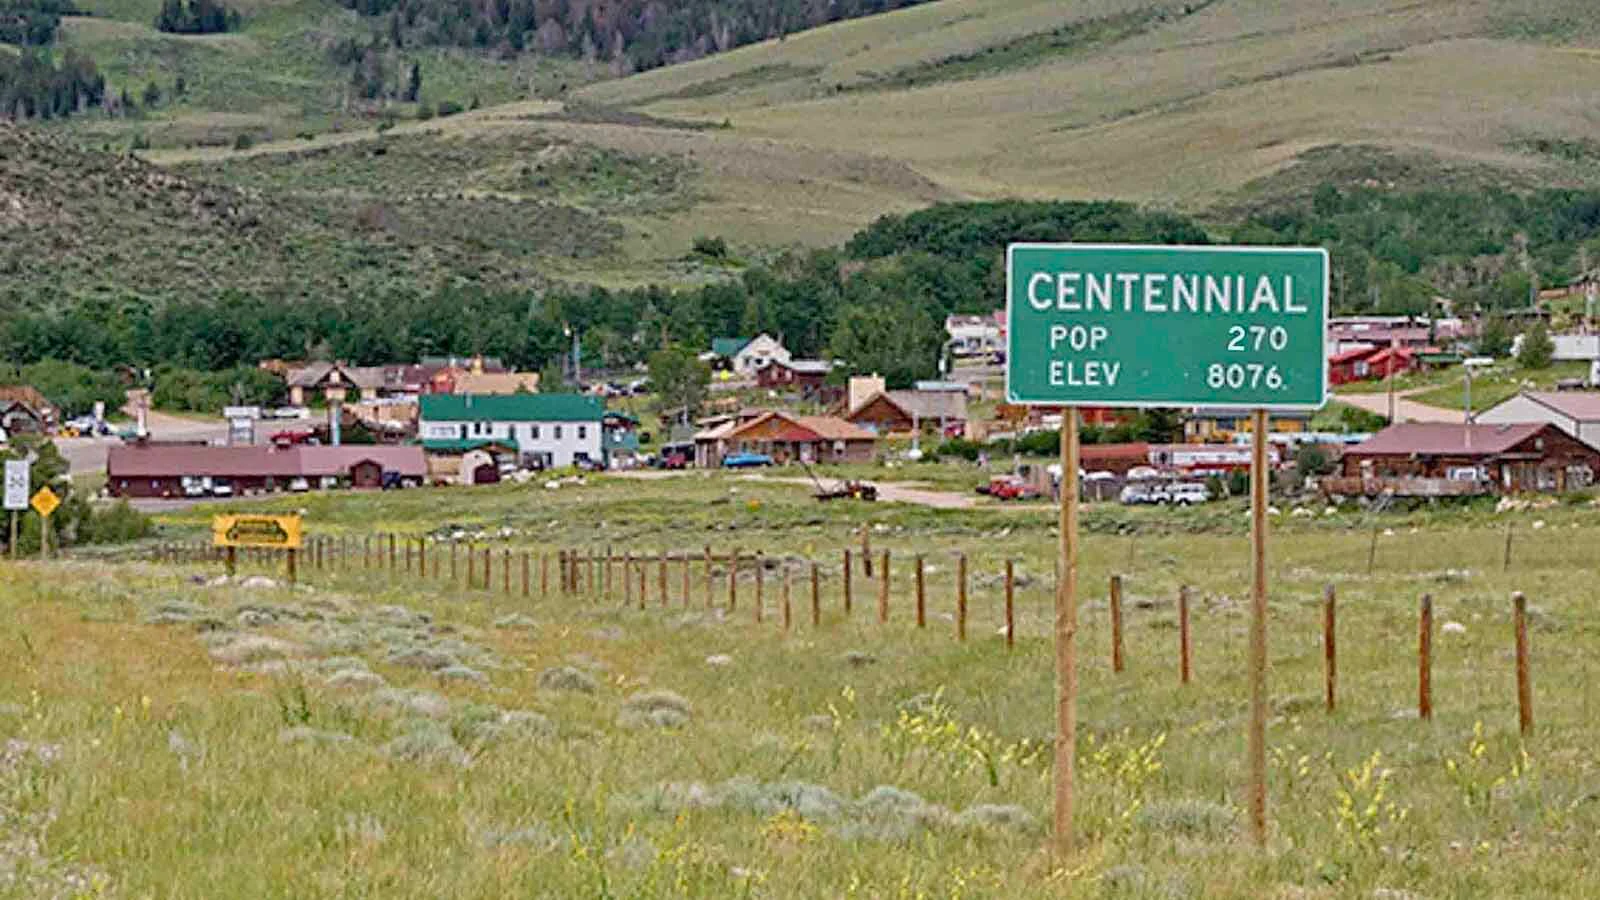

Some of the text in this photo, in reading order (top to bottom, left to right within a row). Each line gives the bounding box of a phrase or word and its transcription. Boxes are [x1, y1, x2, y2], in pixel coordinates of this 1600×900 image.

[1027, 272, 1308, 313] CENTENNIAL
[1050, 326, 1289, 351] POP 270
[1049, 361, 1120, 386] ELEV
